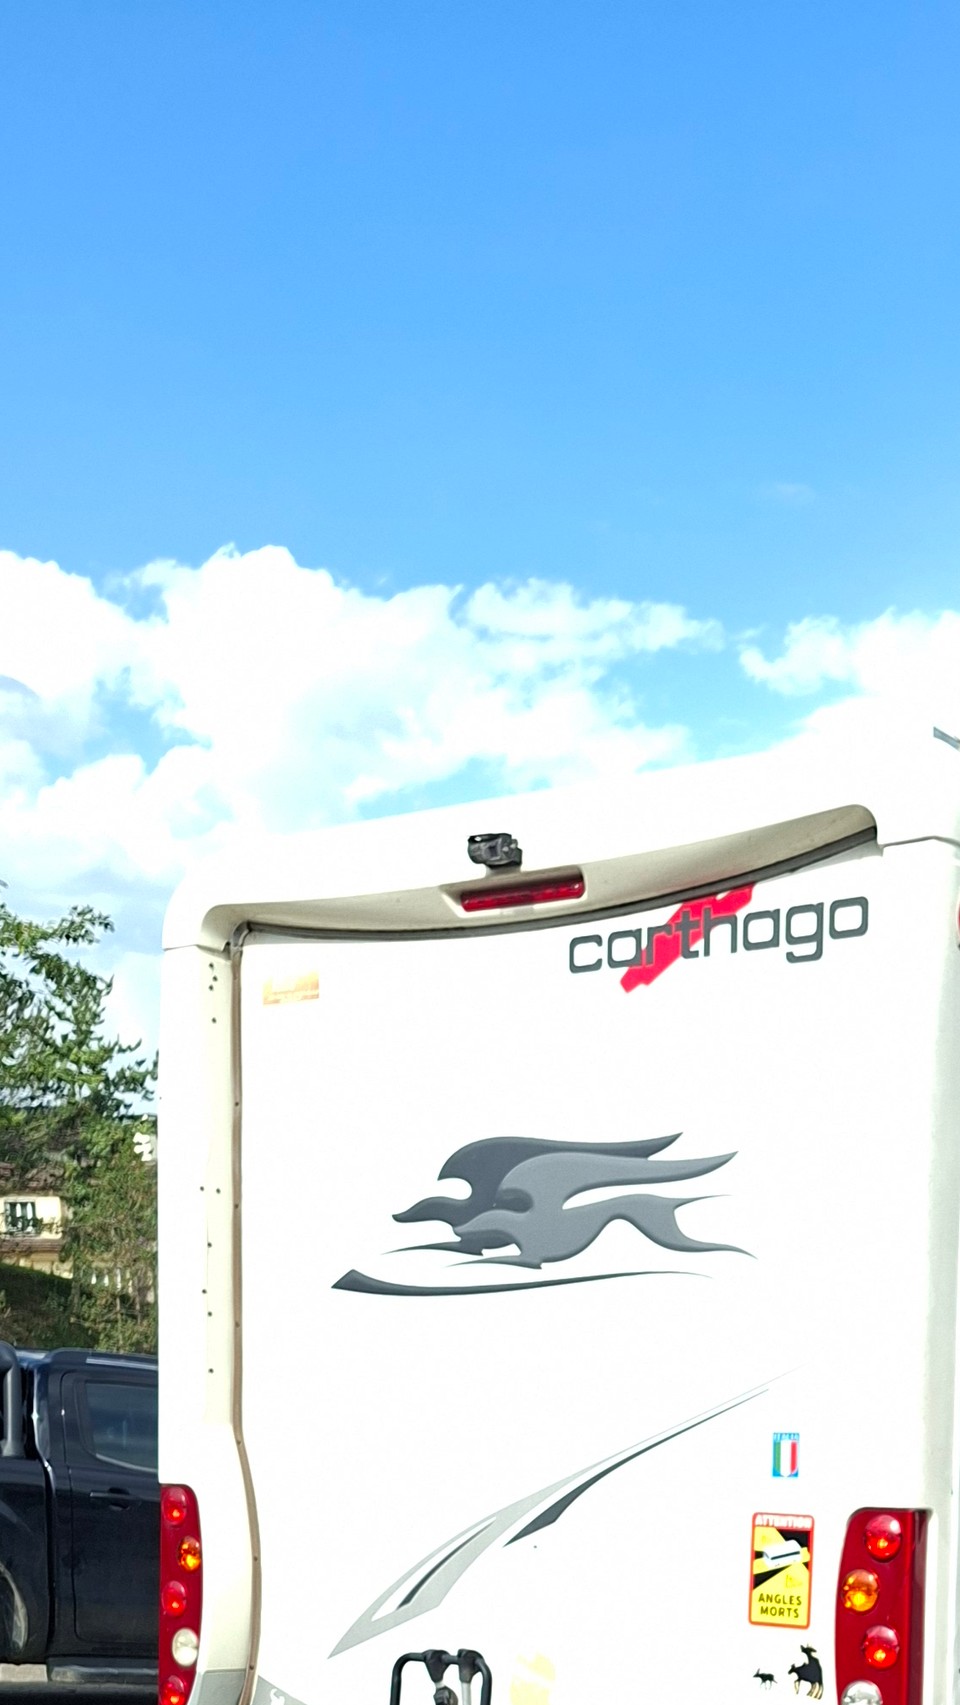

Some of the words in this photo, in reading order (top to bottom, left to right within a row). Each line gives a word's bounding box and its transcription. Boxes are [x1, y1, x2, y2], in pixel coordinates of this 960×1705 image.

[569, 896, 869, 974] carthago
[758, 1593, 802, 1606] ANGLES
[760, 1606, 799, 1618] MORTS
